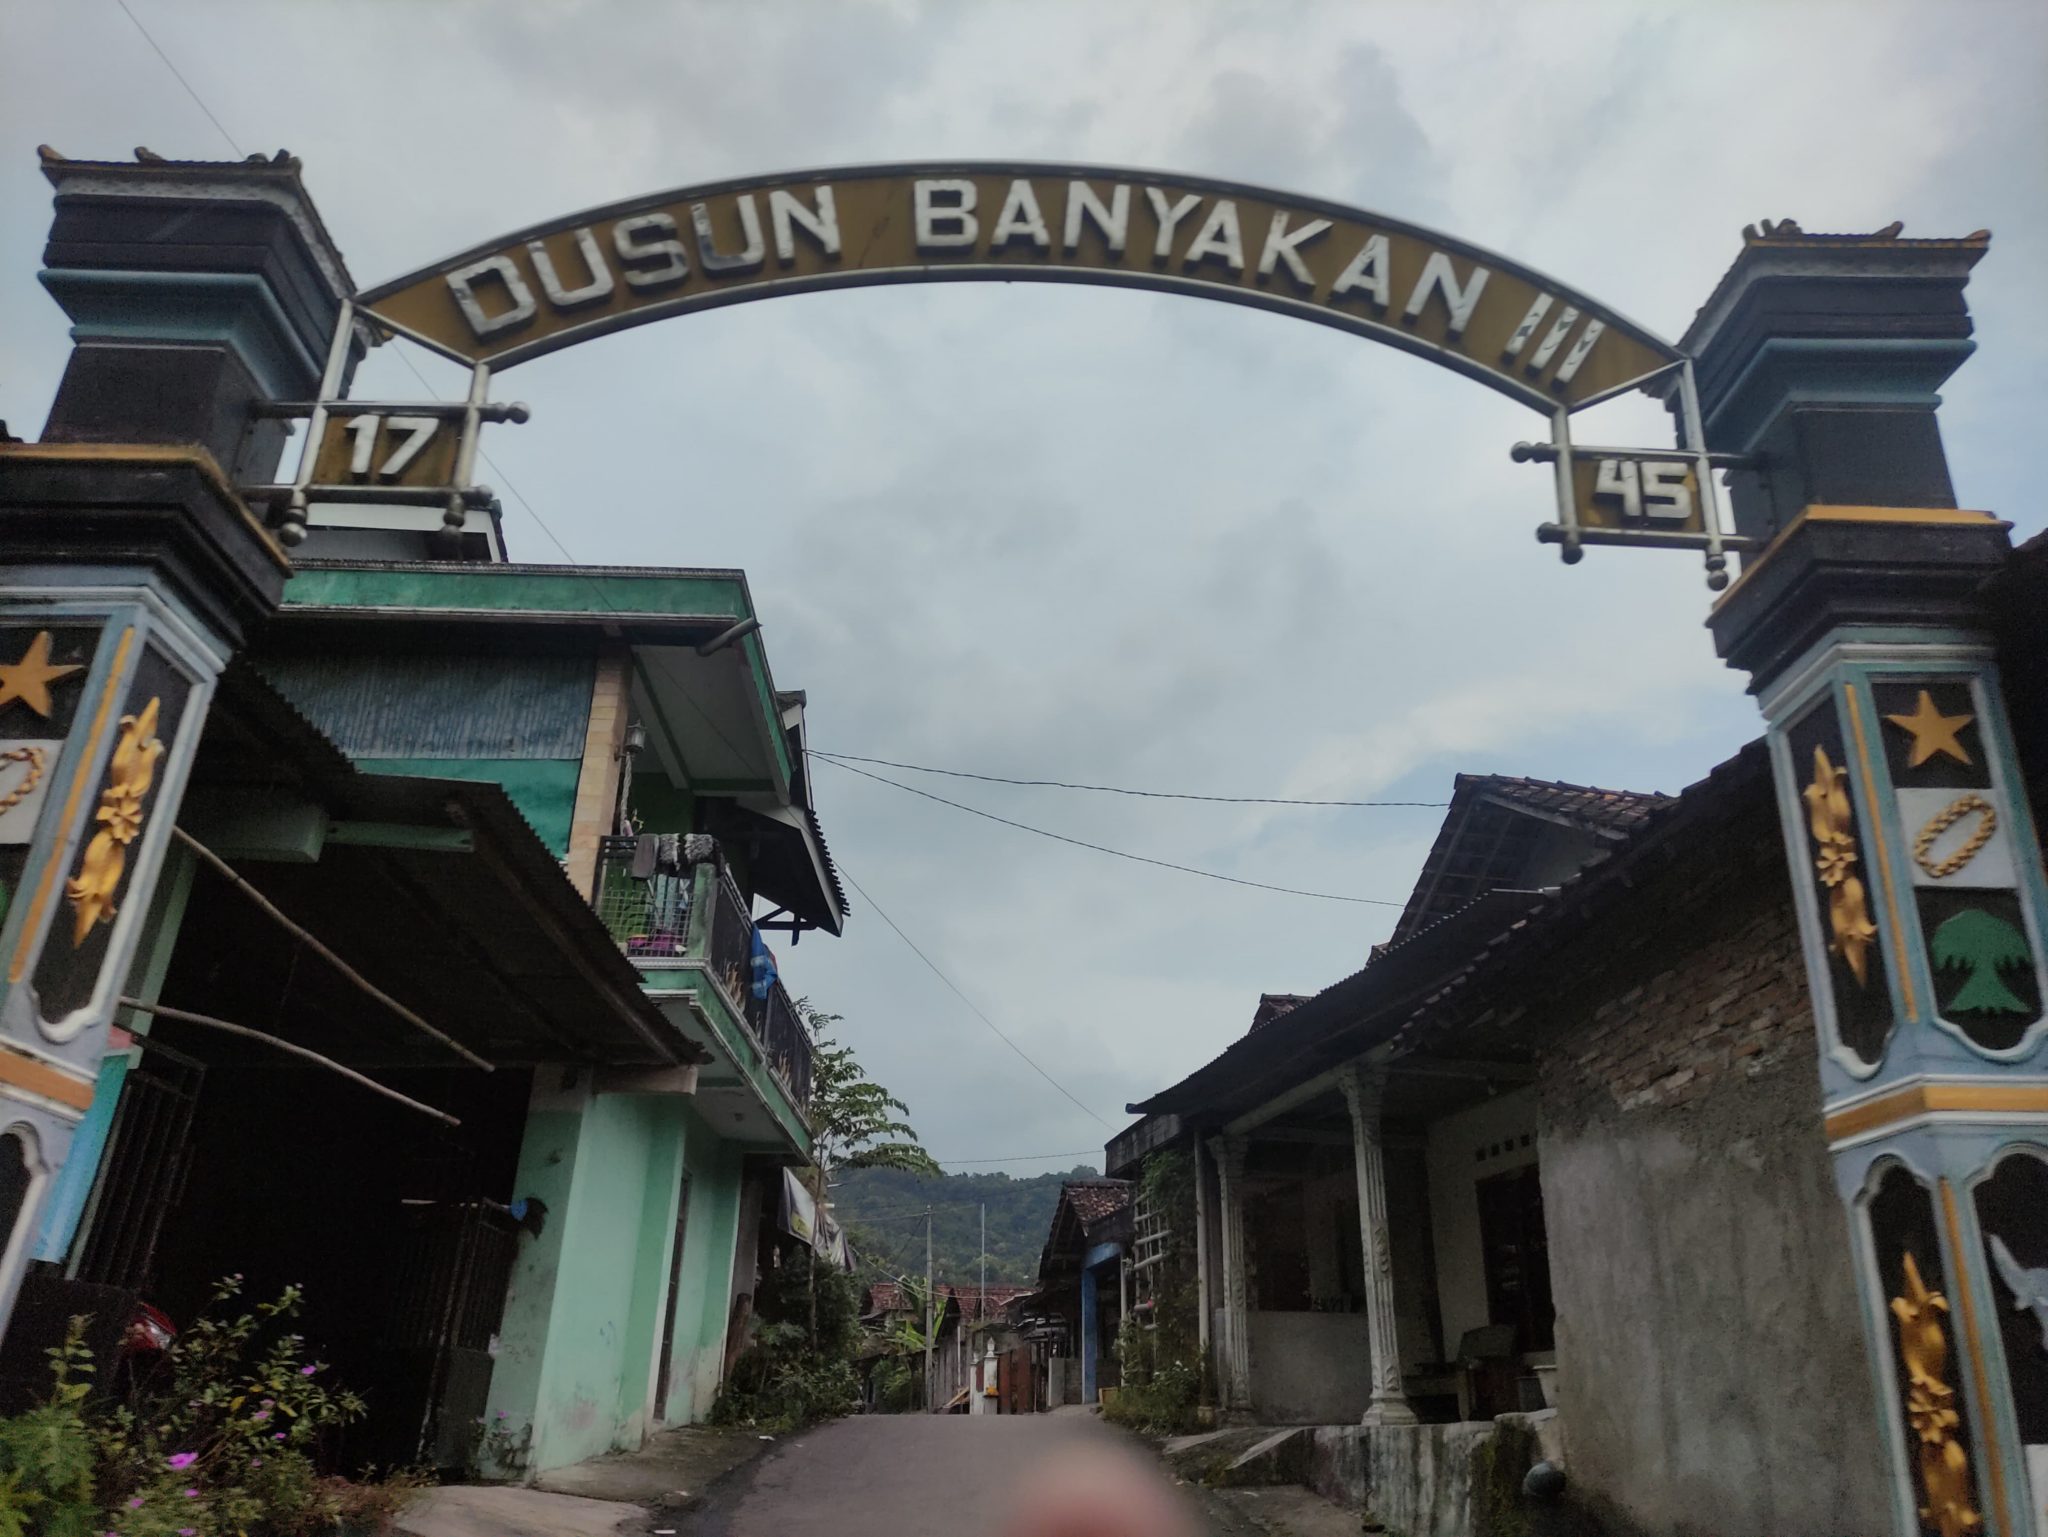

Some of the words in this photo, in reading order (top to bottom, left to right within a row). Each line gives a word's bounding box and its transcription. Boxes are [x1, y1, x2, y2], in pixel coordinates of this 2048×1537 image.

[444, 184, 841, 338] DUSUN
[913, 177, 1489, 339] BANYAKAN
[1503, 292, 1606, 388] III
[344, 414, 440, 480] 17
[1594, 459, 1693, 522] 45
